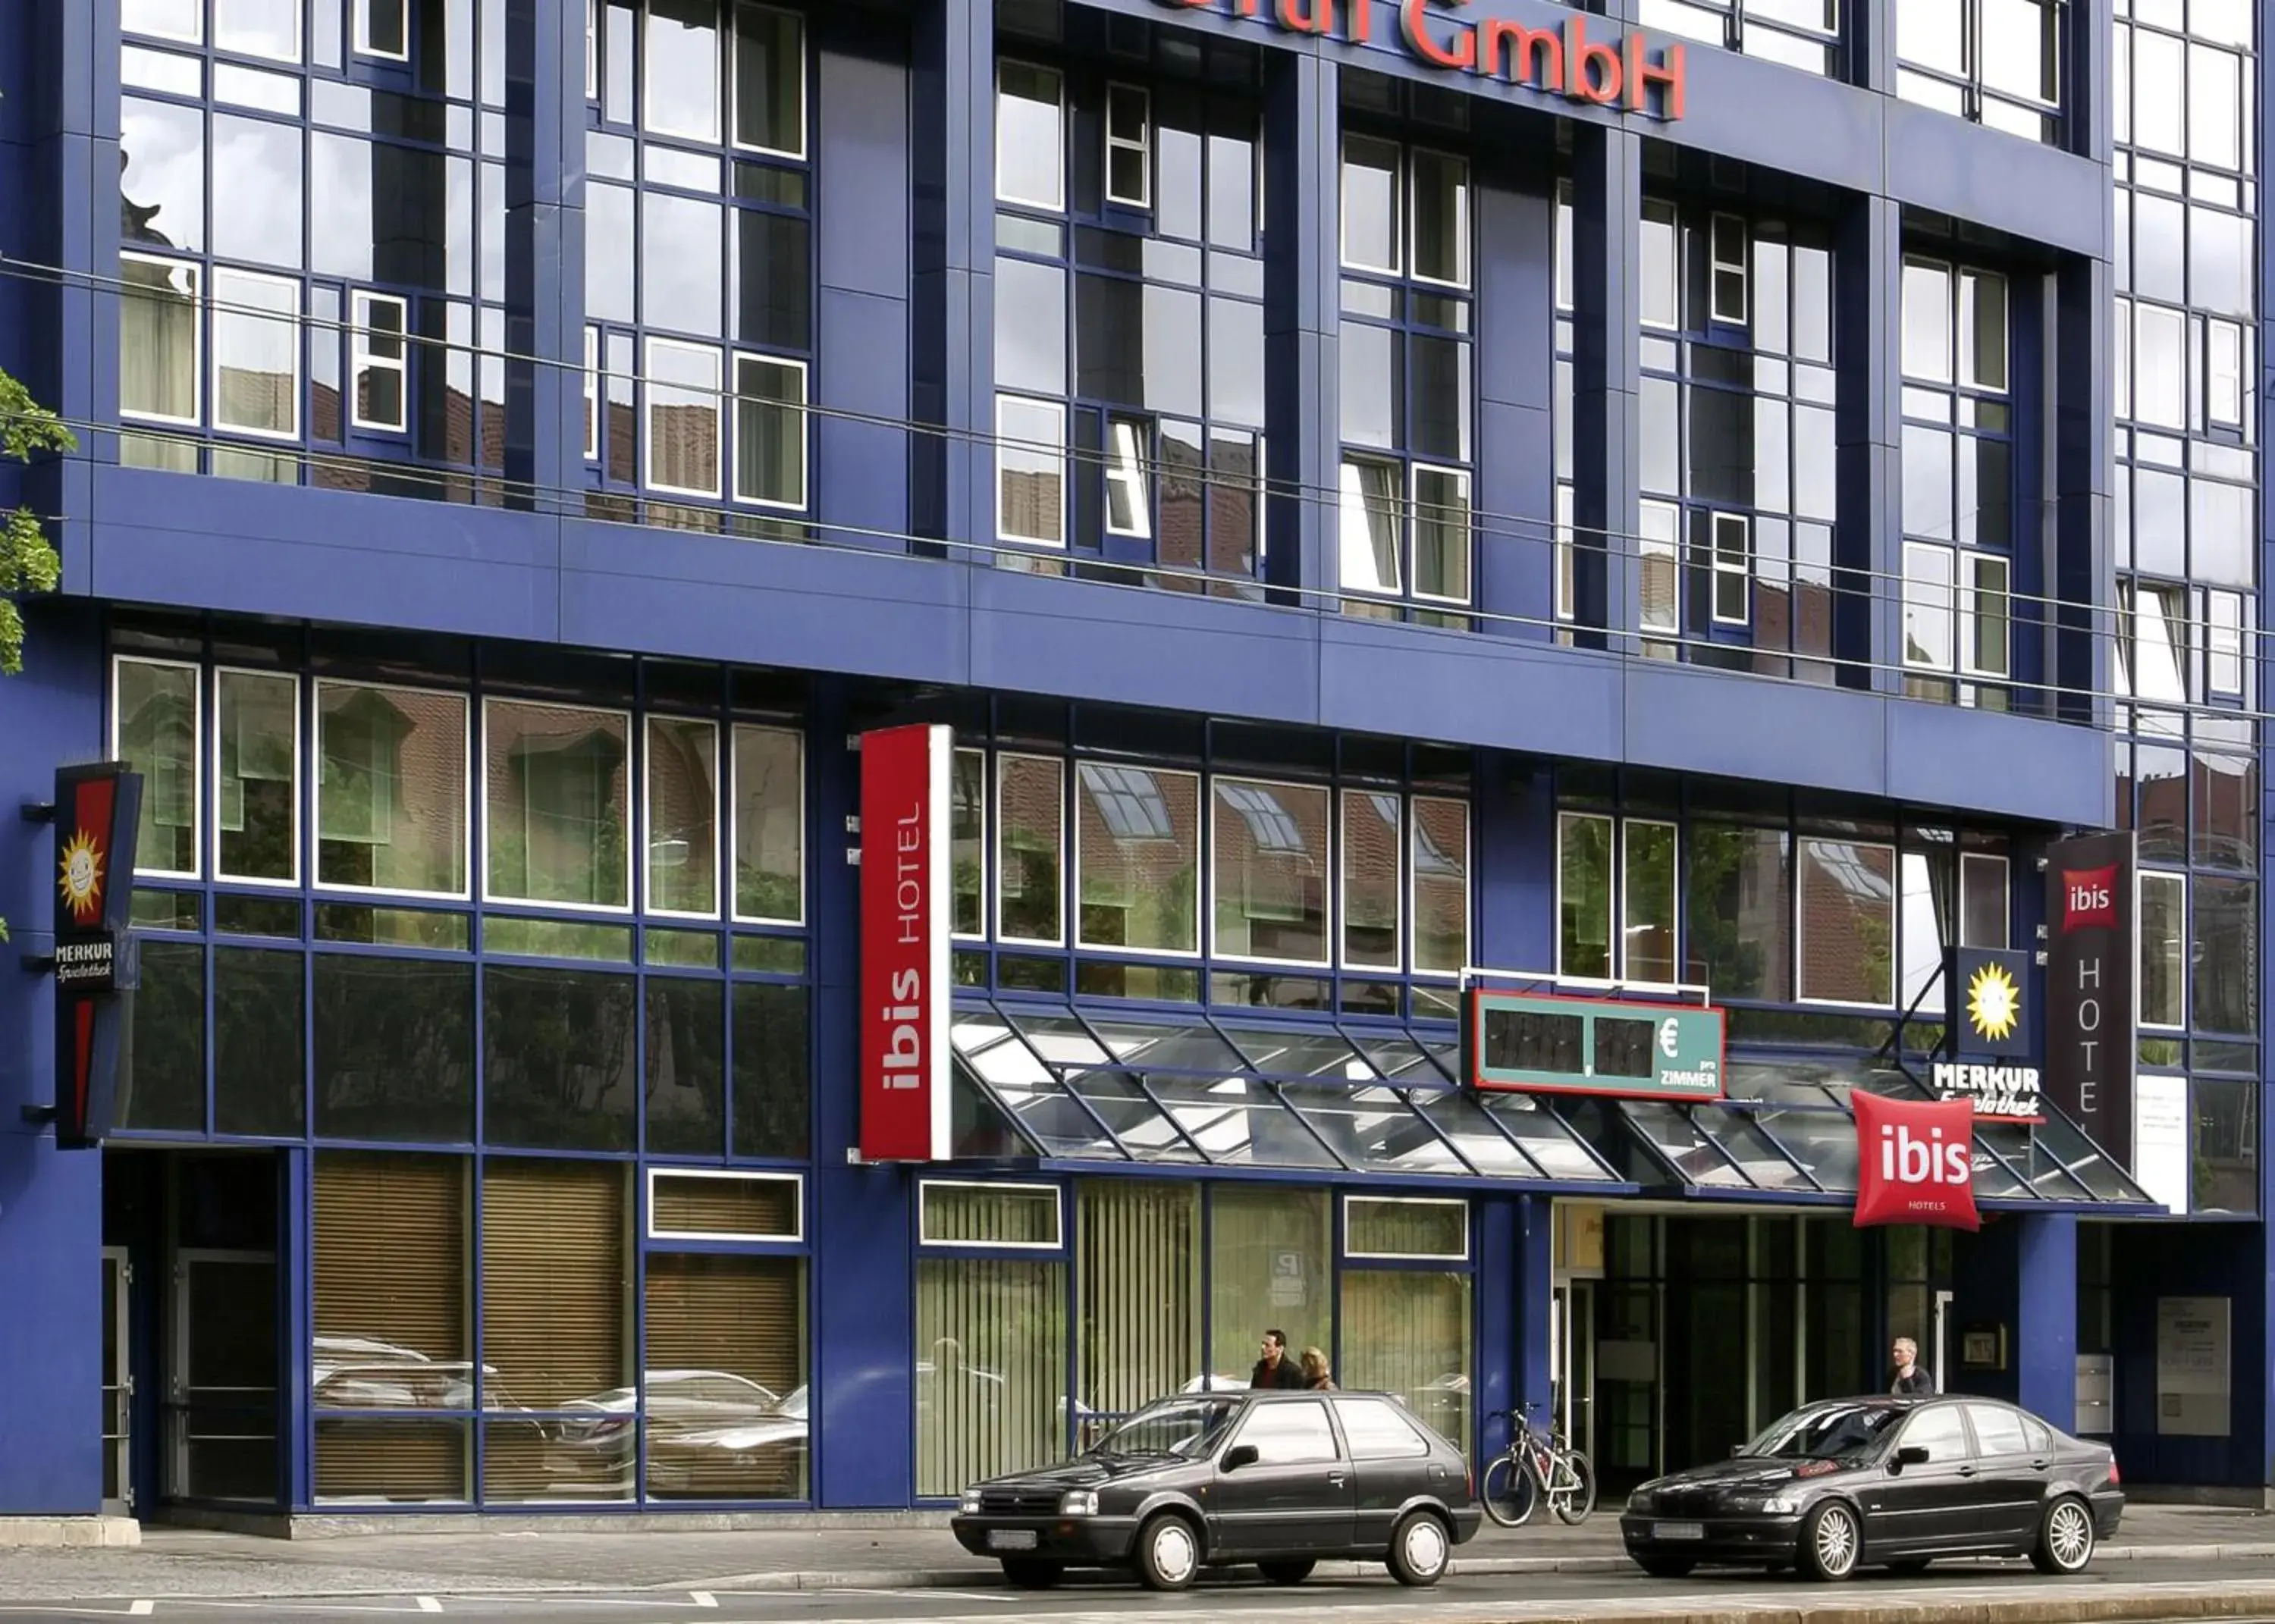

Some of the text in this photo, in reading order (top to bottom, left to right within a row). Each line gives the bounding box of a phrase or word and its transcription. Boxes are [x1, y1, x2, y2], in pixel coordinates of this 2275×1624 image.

[1400, 0, 1685, 121] GmbH
[2071, 884, 2109, 911] ibis
[56, 942, 111, 962] MERKUR
[883, 801, 919, 1089] ibis HOTEL
[1660, 1017, 1678, 1057] €
[2079, 958, 2100, 1132] HOTE
[1661, 1070, 1715, 1087] ZIMMER
[1934, 1063, 2040, 1092] MERKUR
[1881, 1124, 1969, 1184] ibis
[1909, 1200, 1946, 1211] HOTELS
